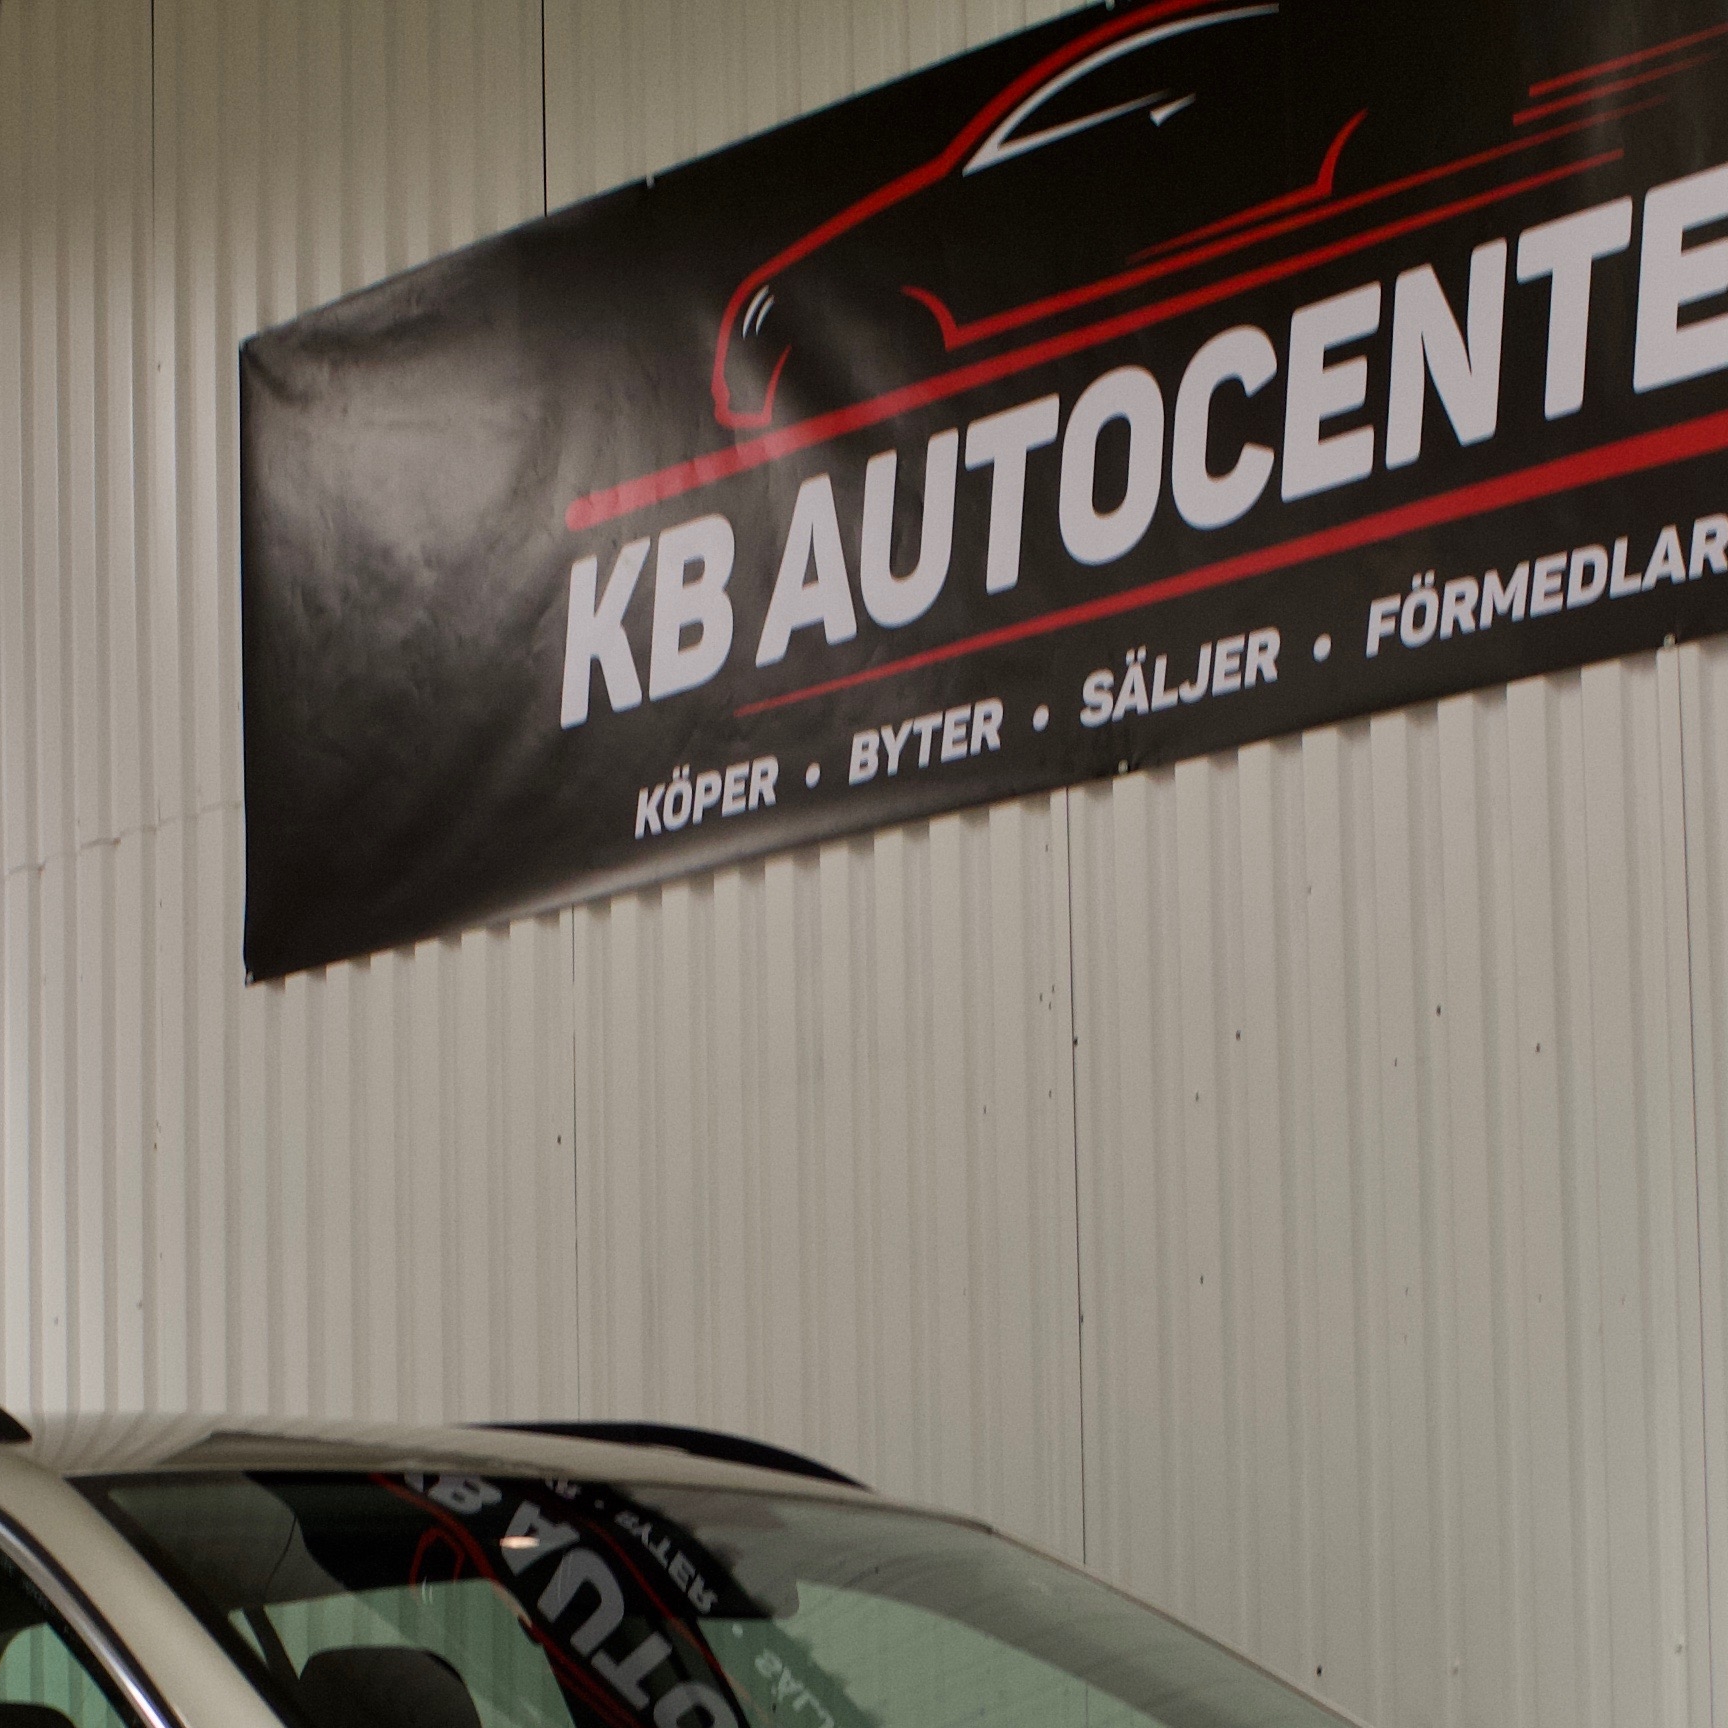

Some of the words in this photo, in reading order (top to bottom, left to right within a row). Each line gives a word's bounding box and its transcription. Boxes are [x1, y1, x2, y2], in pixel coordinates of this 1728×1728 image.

[560, 511, 736, 731] KB
[632, 755, 780, 839] KÖPER
[847, 698, 1005, 788] BYTER
[1078, 626, 1283, 730] SÄLJER
